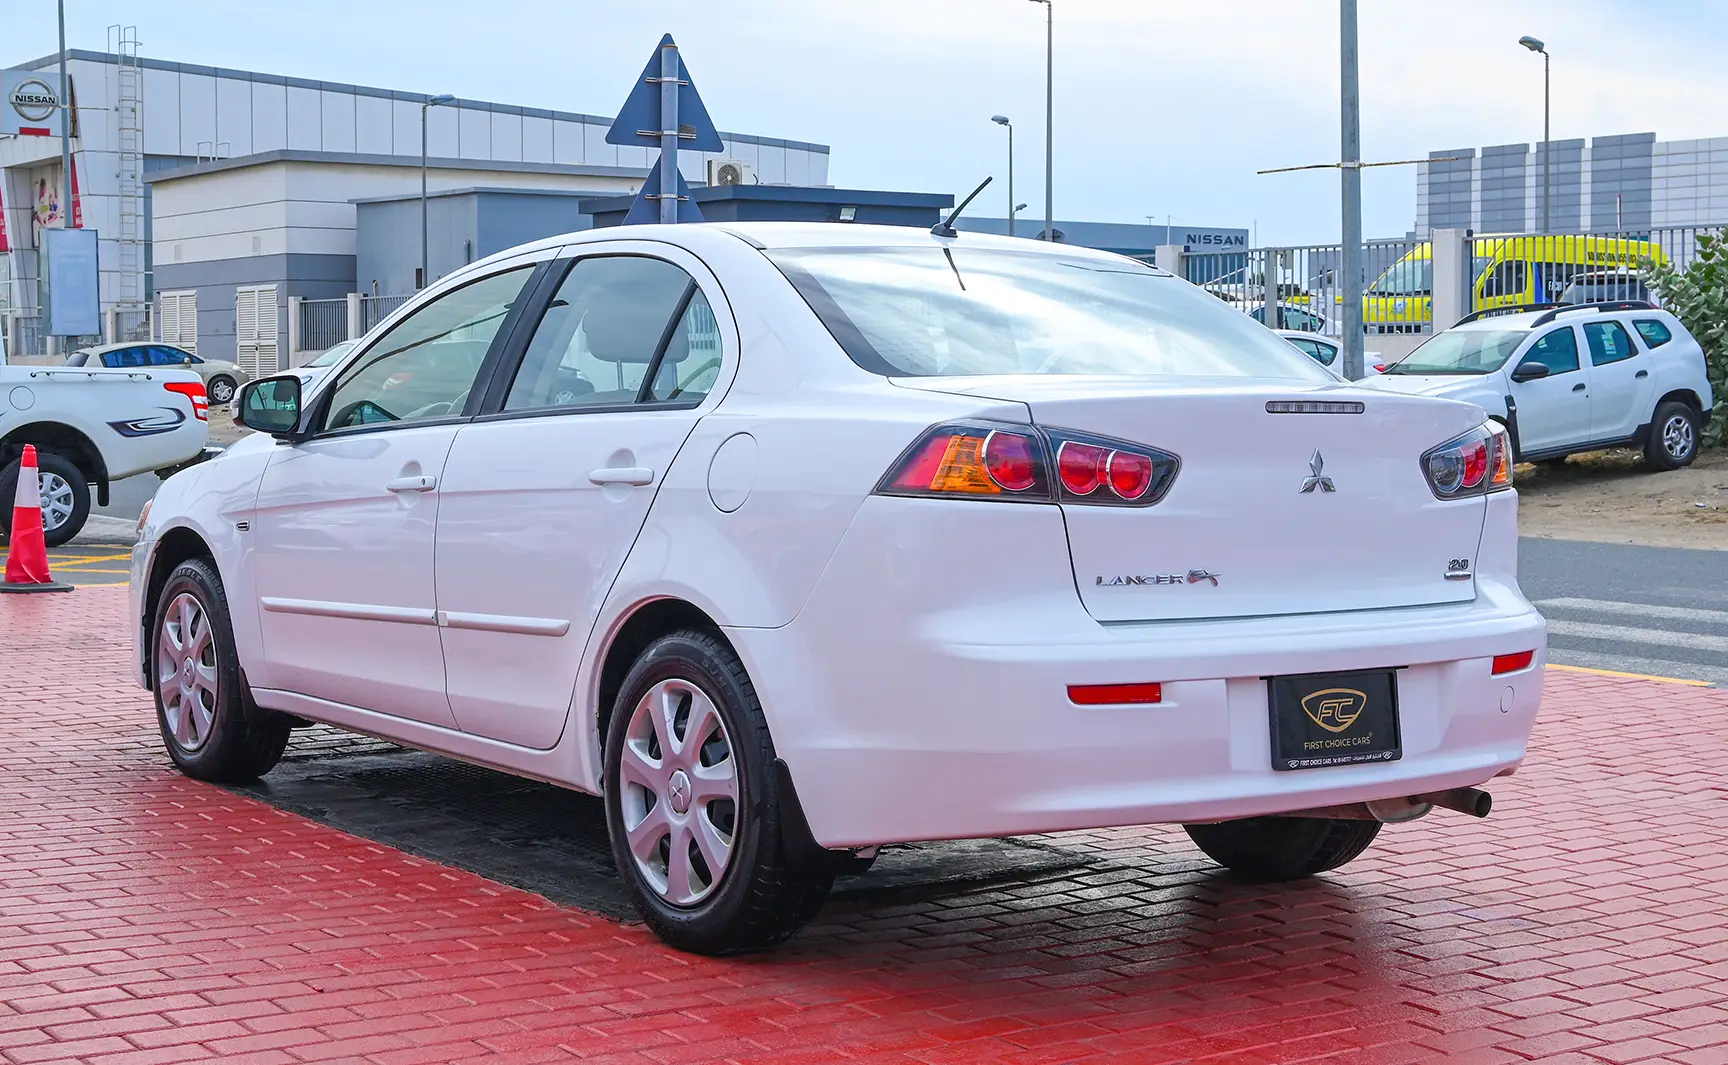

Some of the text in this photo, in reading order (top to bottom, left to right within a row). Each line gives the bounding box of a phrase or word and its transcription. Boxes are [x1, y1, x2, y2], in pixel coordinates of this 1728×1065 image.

[15, 95, 56, 104] NISSAN
[1187, 234, 1244, 245] NISSAN
[1096, 575, 1184, 587] LANCER
[1304, 736, 1371, 750] FIRST CHOICE CARS
